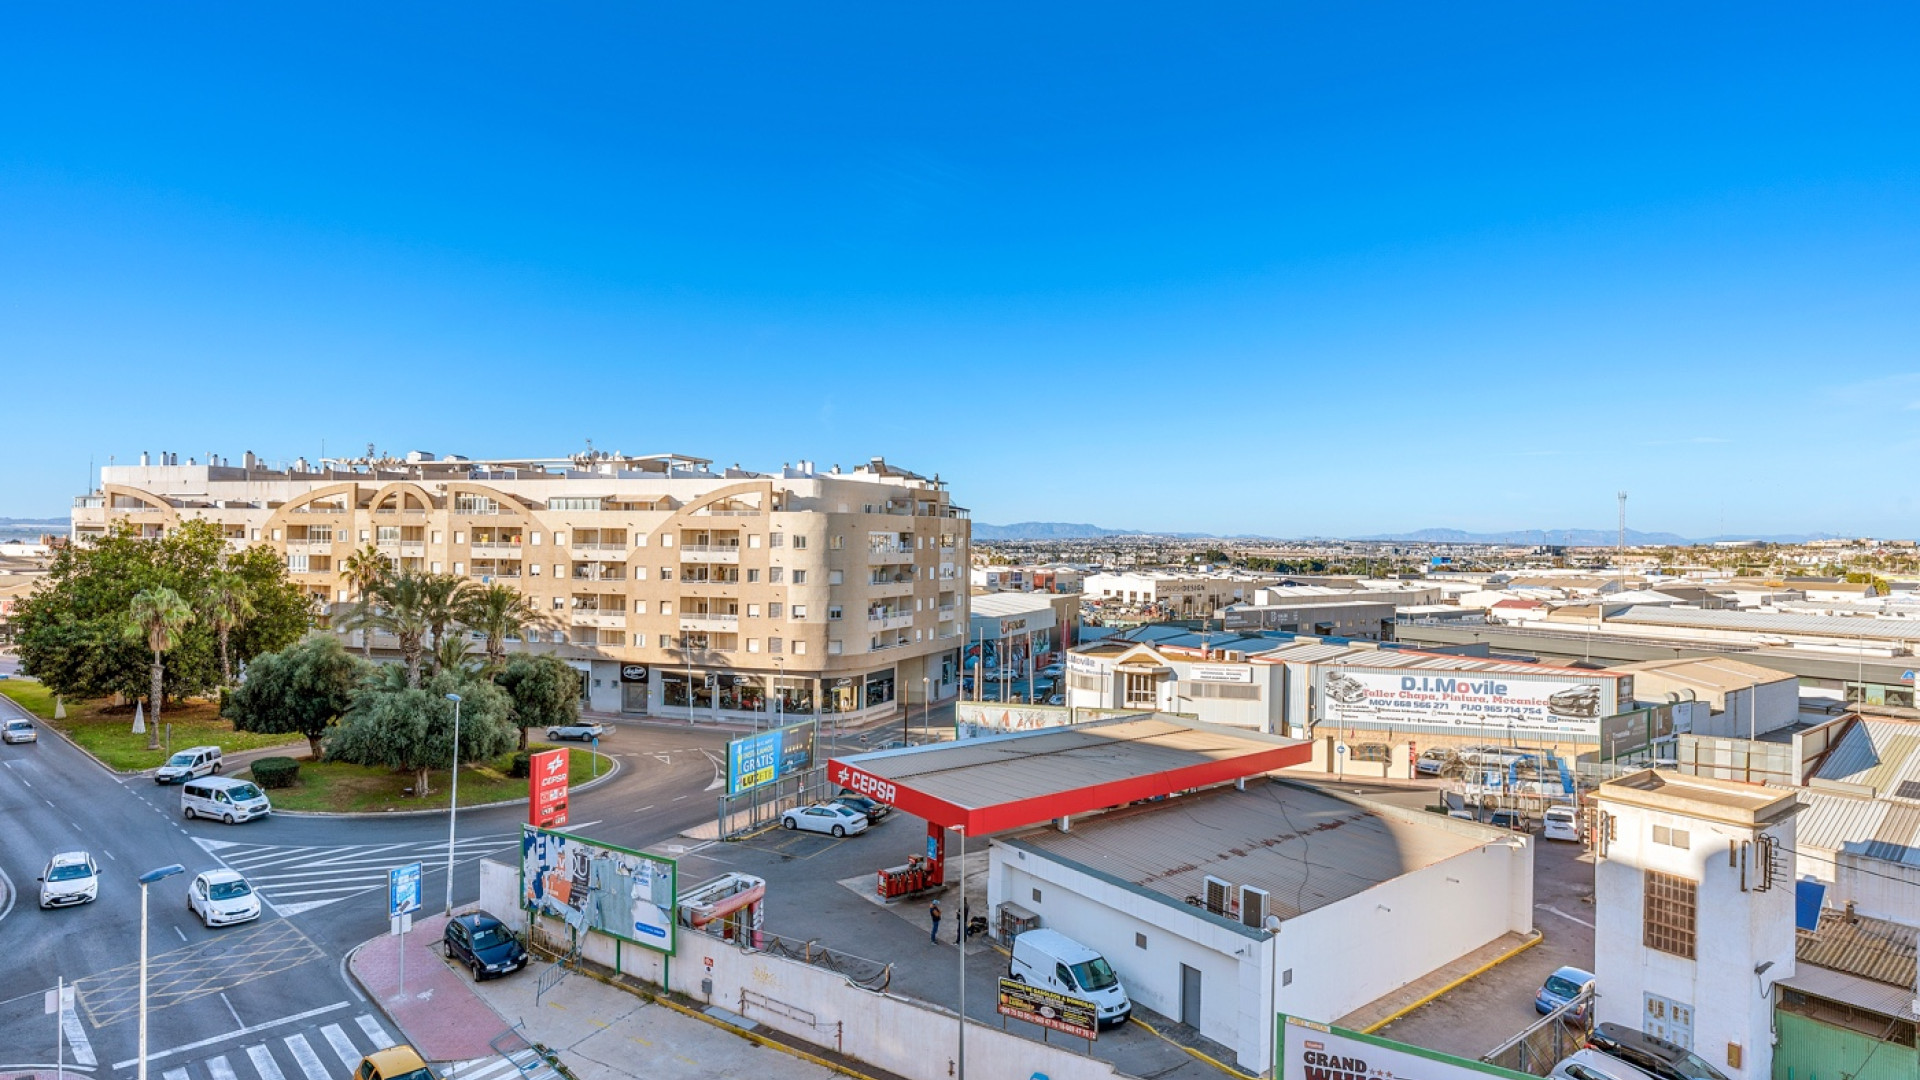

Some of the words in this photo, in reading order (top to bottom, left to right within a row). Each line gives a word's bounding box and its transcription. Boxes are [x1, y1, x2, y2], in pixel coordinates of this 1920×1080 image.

[1362, 688, 1396, 699] Taller
[1398, 690, 1439, 702] Chapa,
[1442, 692, 1489, 704] Pintura,
[1401, 676, 1508, 696] D.I.Movile
[1369, 699, 1392, 707] MOV
[1433, 702, 1449, 710] 271
[1484, 705, 1502, 713] 965
[1523, 707, 1542, 715] 754
[742, 752, 774, 773] GRATIS
[541, 773, 567, 786] CEPSA
[851, 771, 896, 803] CEPSA
[1303, 1050, 1367, 1073] GRAND
